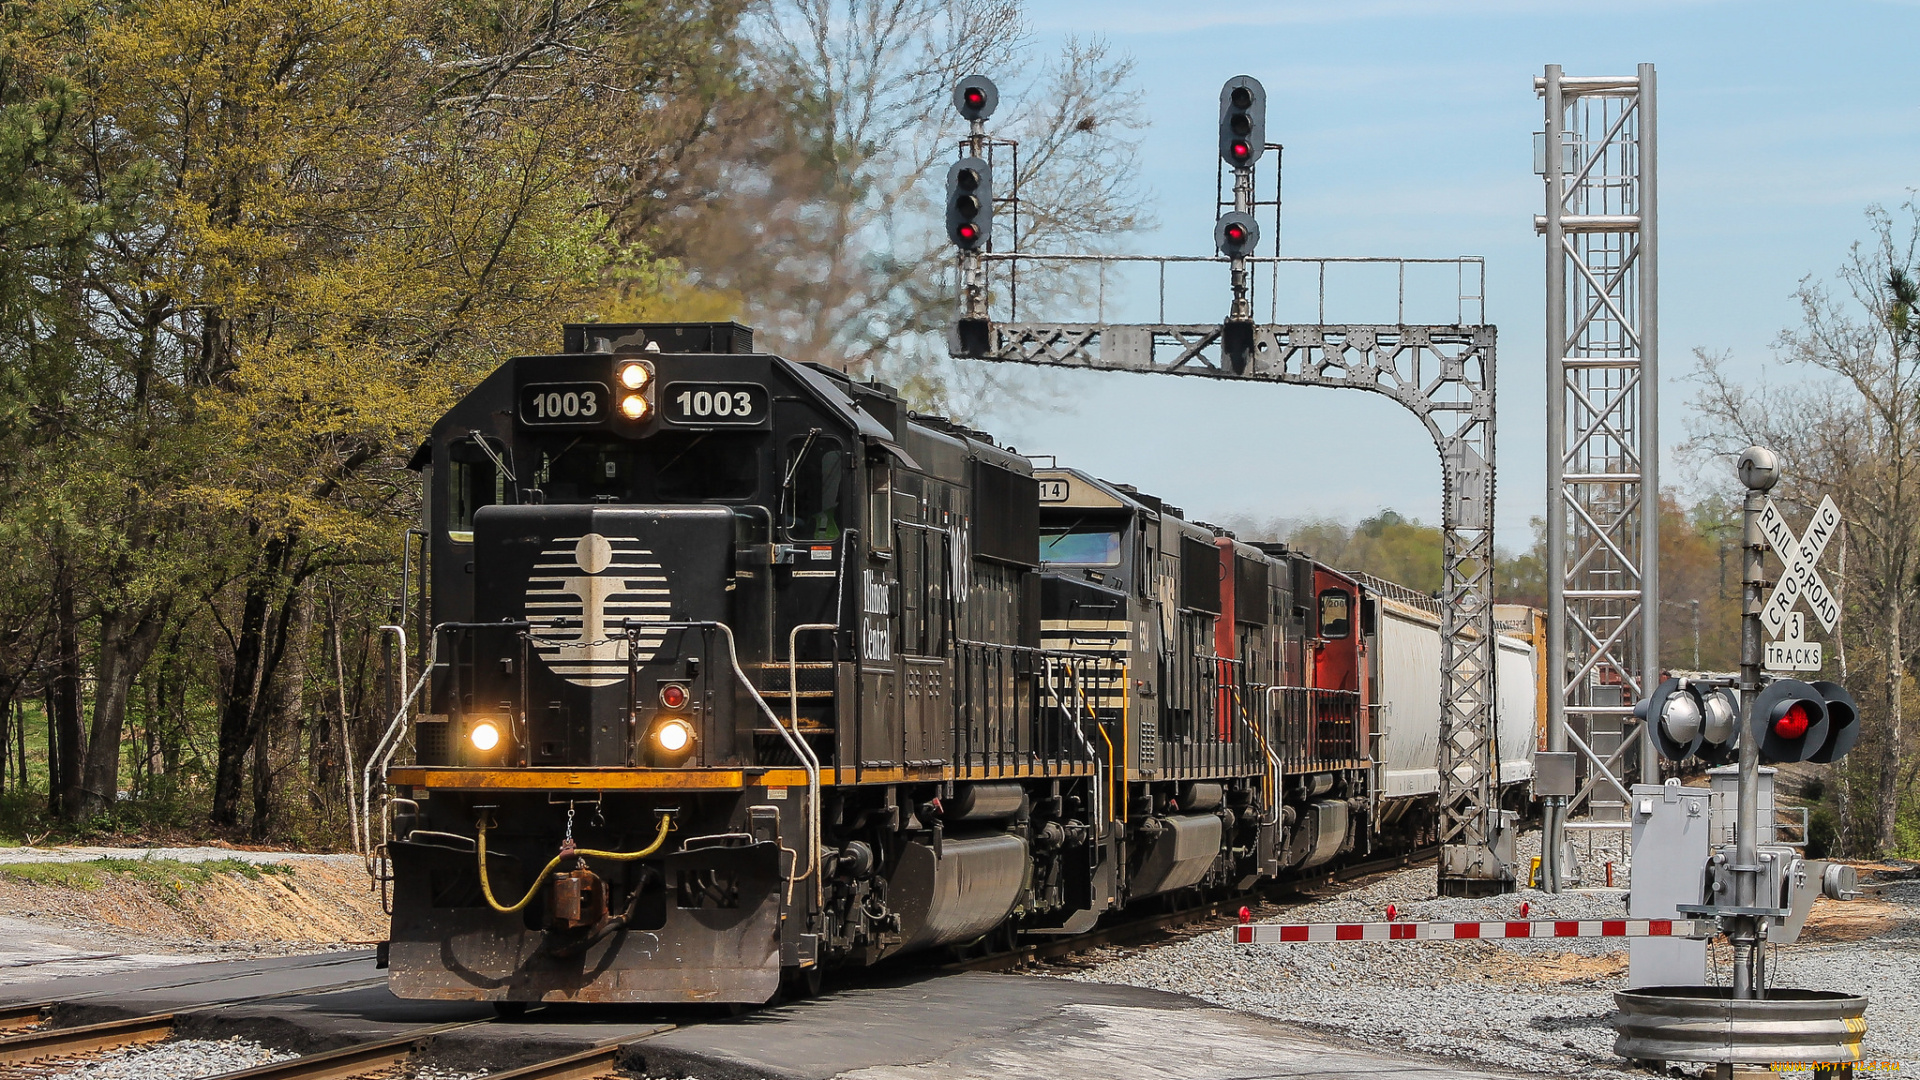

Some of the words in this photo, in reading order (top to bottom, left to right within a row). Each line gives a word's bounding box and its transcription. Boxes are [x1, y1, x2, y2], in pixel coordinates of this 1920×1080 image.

[533, 391, 597, 418] 1003
[676, 391, 752, 416] 1003
[1761, 506, 1791, 559] RAIL
[1802, 572, 1836, 624] ROAD
[1769, 508, 1835, 625] CROSSING
[863, 569, 889, 615] Illinois
[863, 617, 890, 661] Central
[1790, 617, 1799, 639] 3
[1767, 648, 1819, 664] TRACKS
